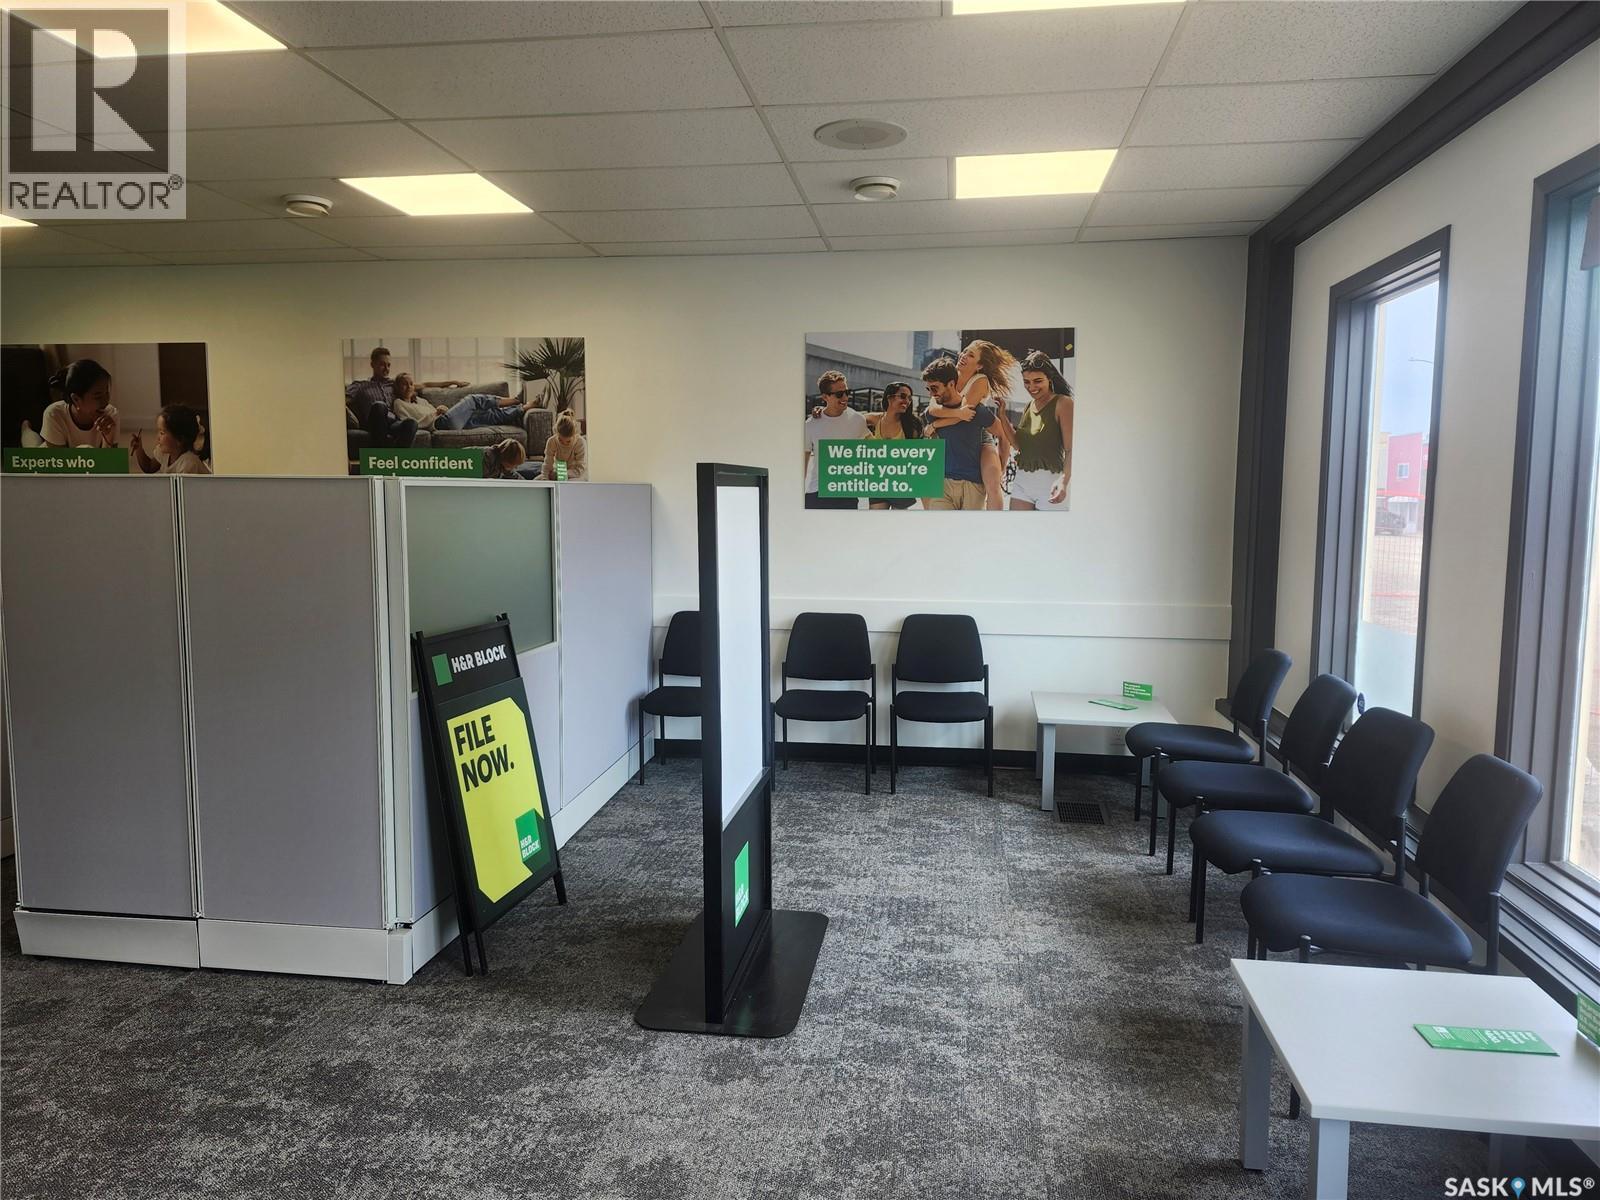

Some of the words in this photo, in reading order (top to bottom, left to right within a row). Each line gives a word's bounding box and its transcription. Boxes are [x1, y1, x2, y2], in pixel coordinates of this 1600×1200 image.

[827, 445, 853, 459] We
[856, 445, 887, 459] find
[890, 447, 936, 461] every
[11, 456, 64, 470] Experts
[66, 456, 95, 469] who
[368, 456, 399, 470] Feel
[401, 456, 474, 470] confident
[827, 462, 875, 476] credit
[877, 462, 928, 478] you're
[827, 479, 889, 492] entitled
[892, 480, 913, 492] to.
[451, 653, 475, 674] H&R
[474, 644, 507, 668] BLOCK
[453, 714, 496, 757] FILE
[461, 744, 515, 793] NOW.
